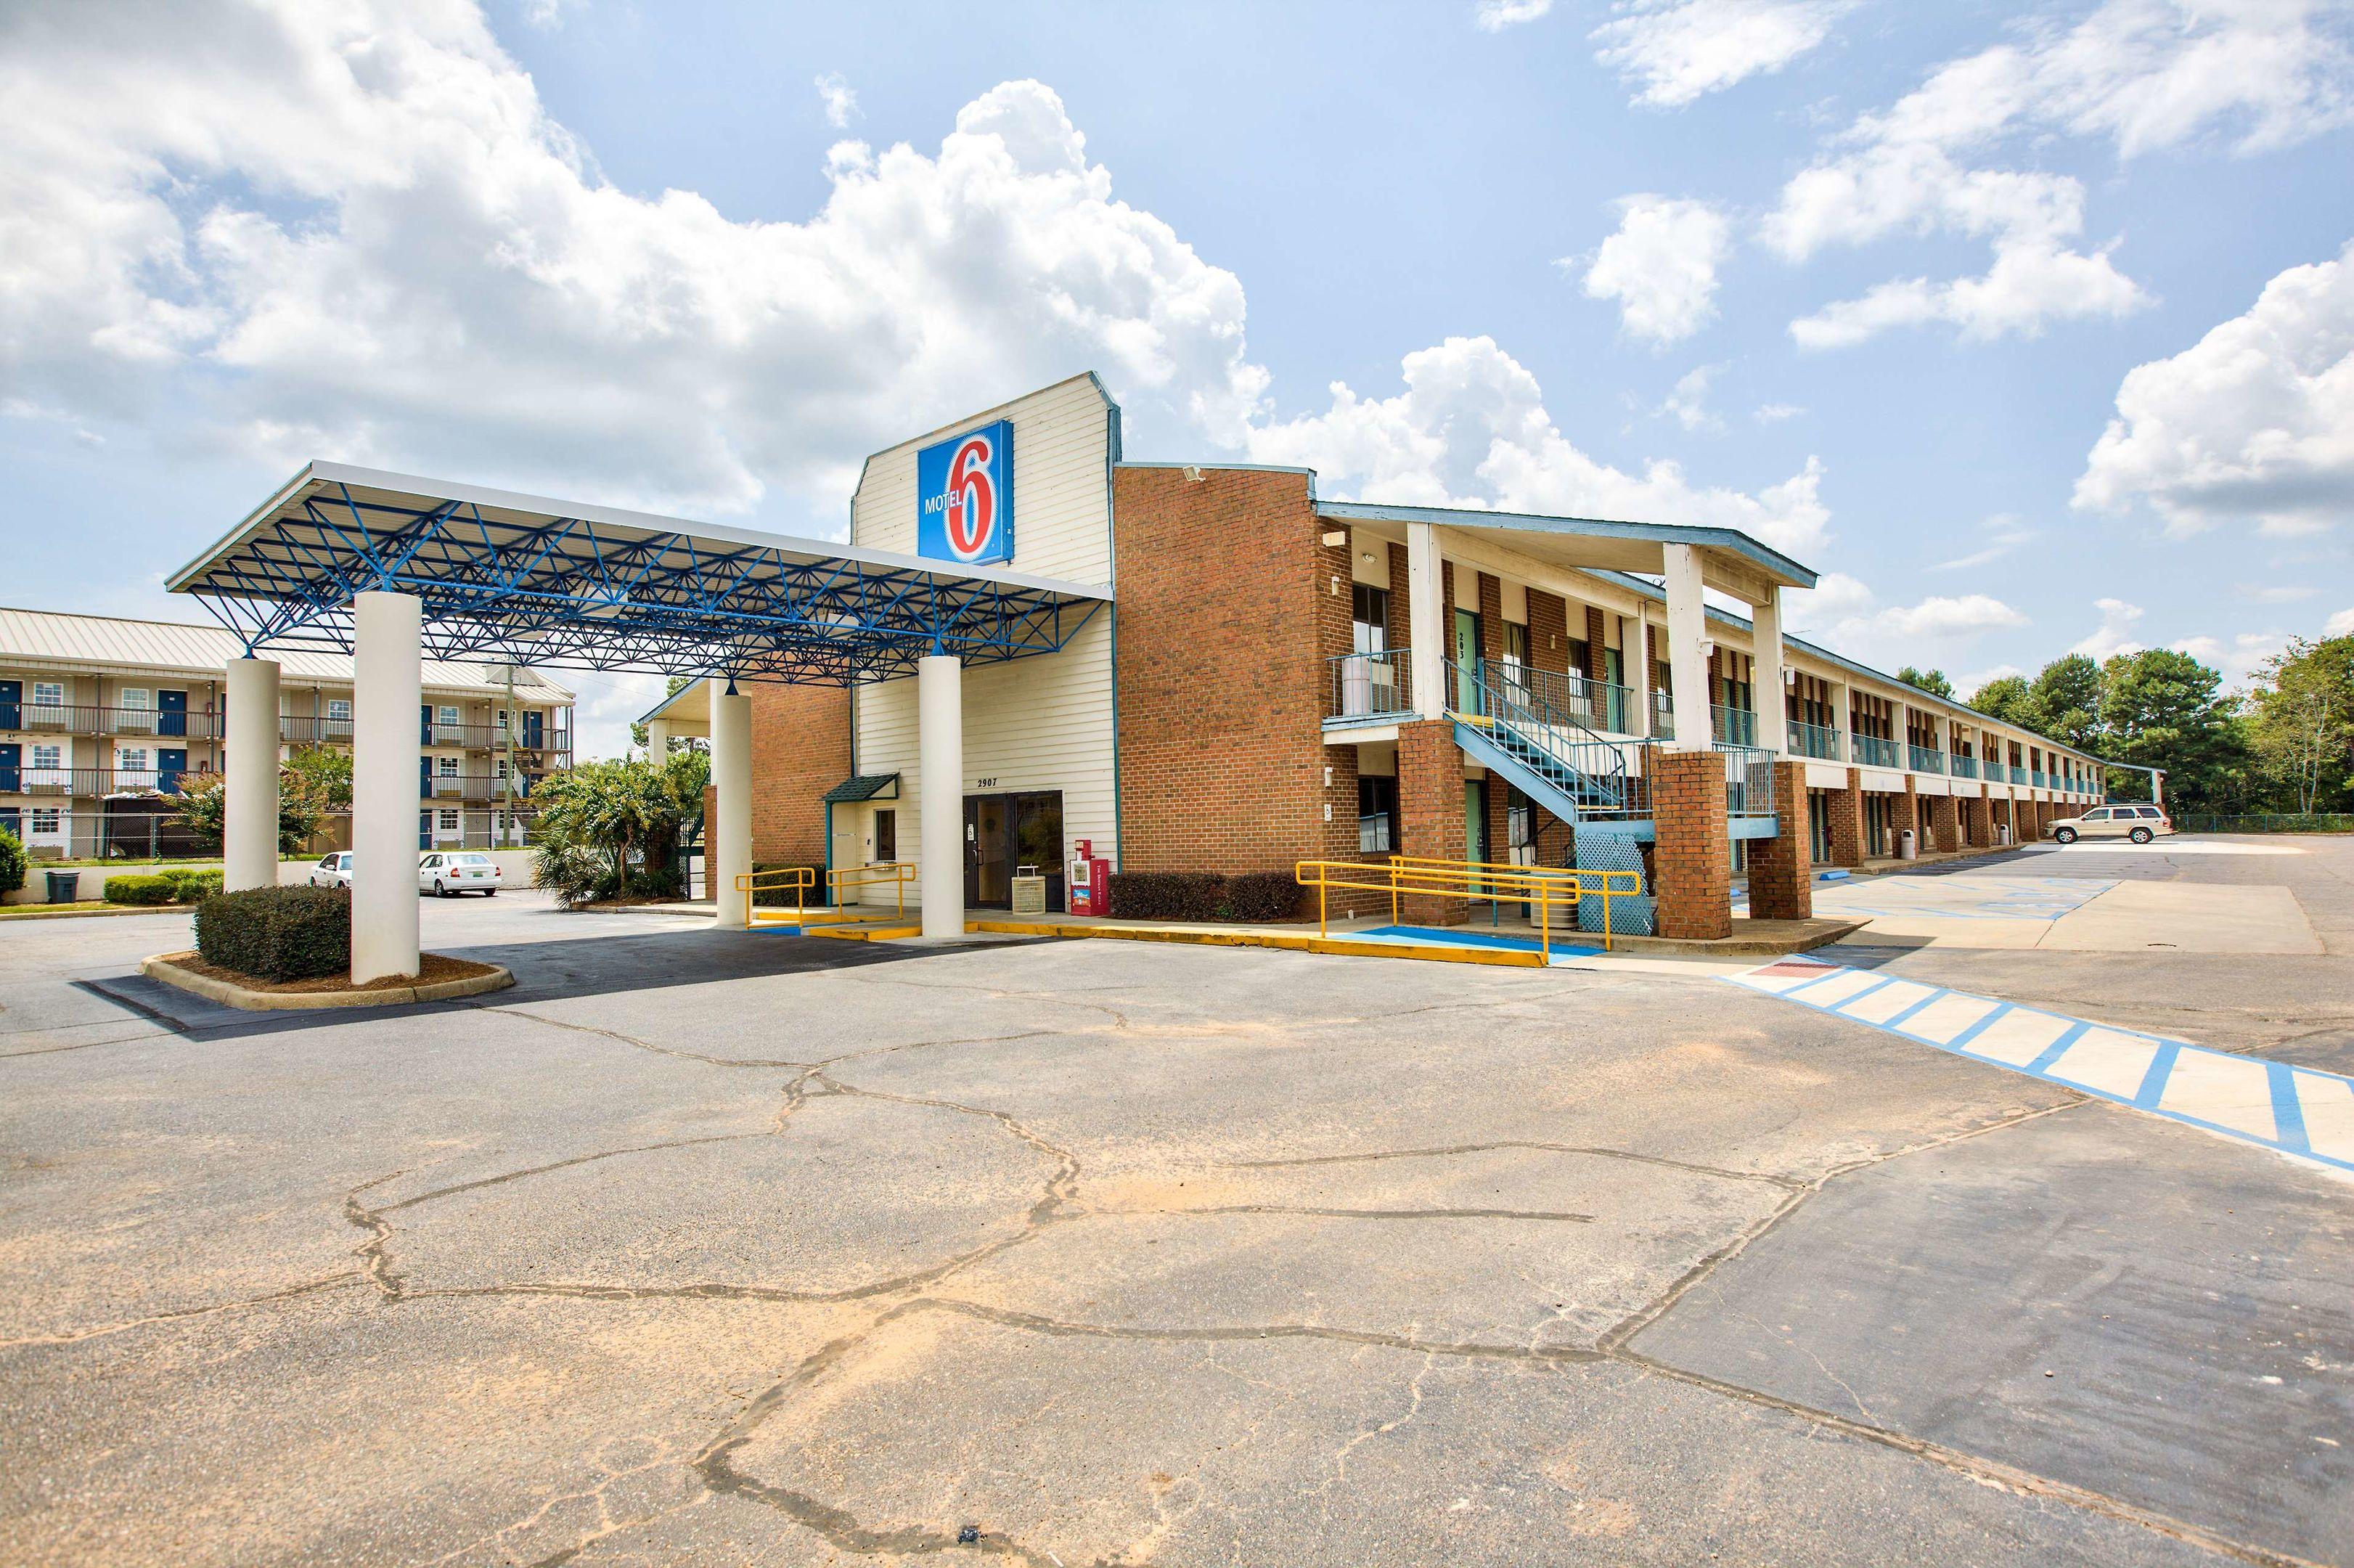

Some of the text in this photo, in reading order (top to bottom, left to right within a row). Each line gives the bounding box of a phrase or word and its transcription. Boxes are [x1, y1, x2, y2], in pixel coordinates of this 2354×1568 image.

[925, 441, 992, 553] MOTEL 6
[978, 778, 997, 788] 2907
